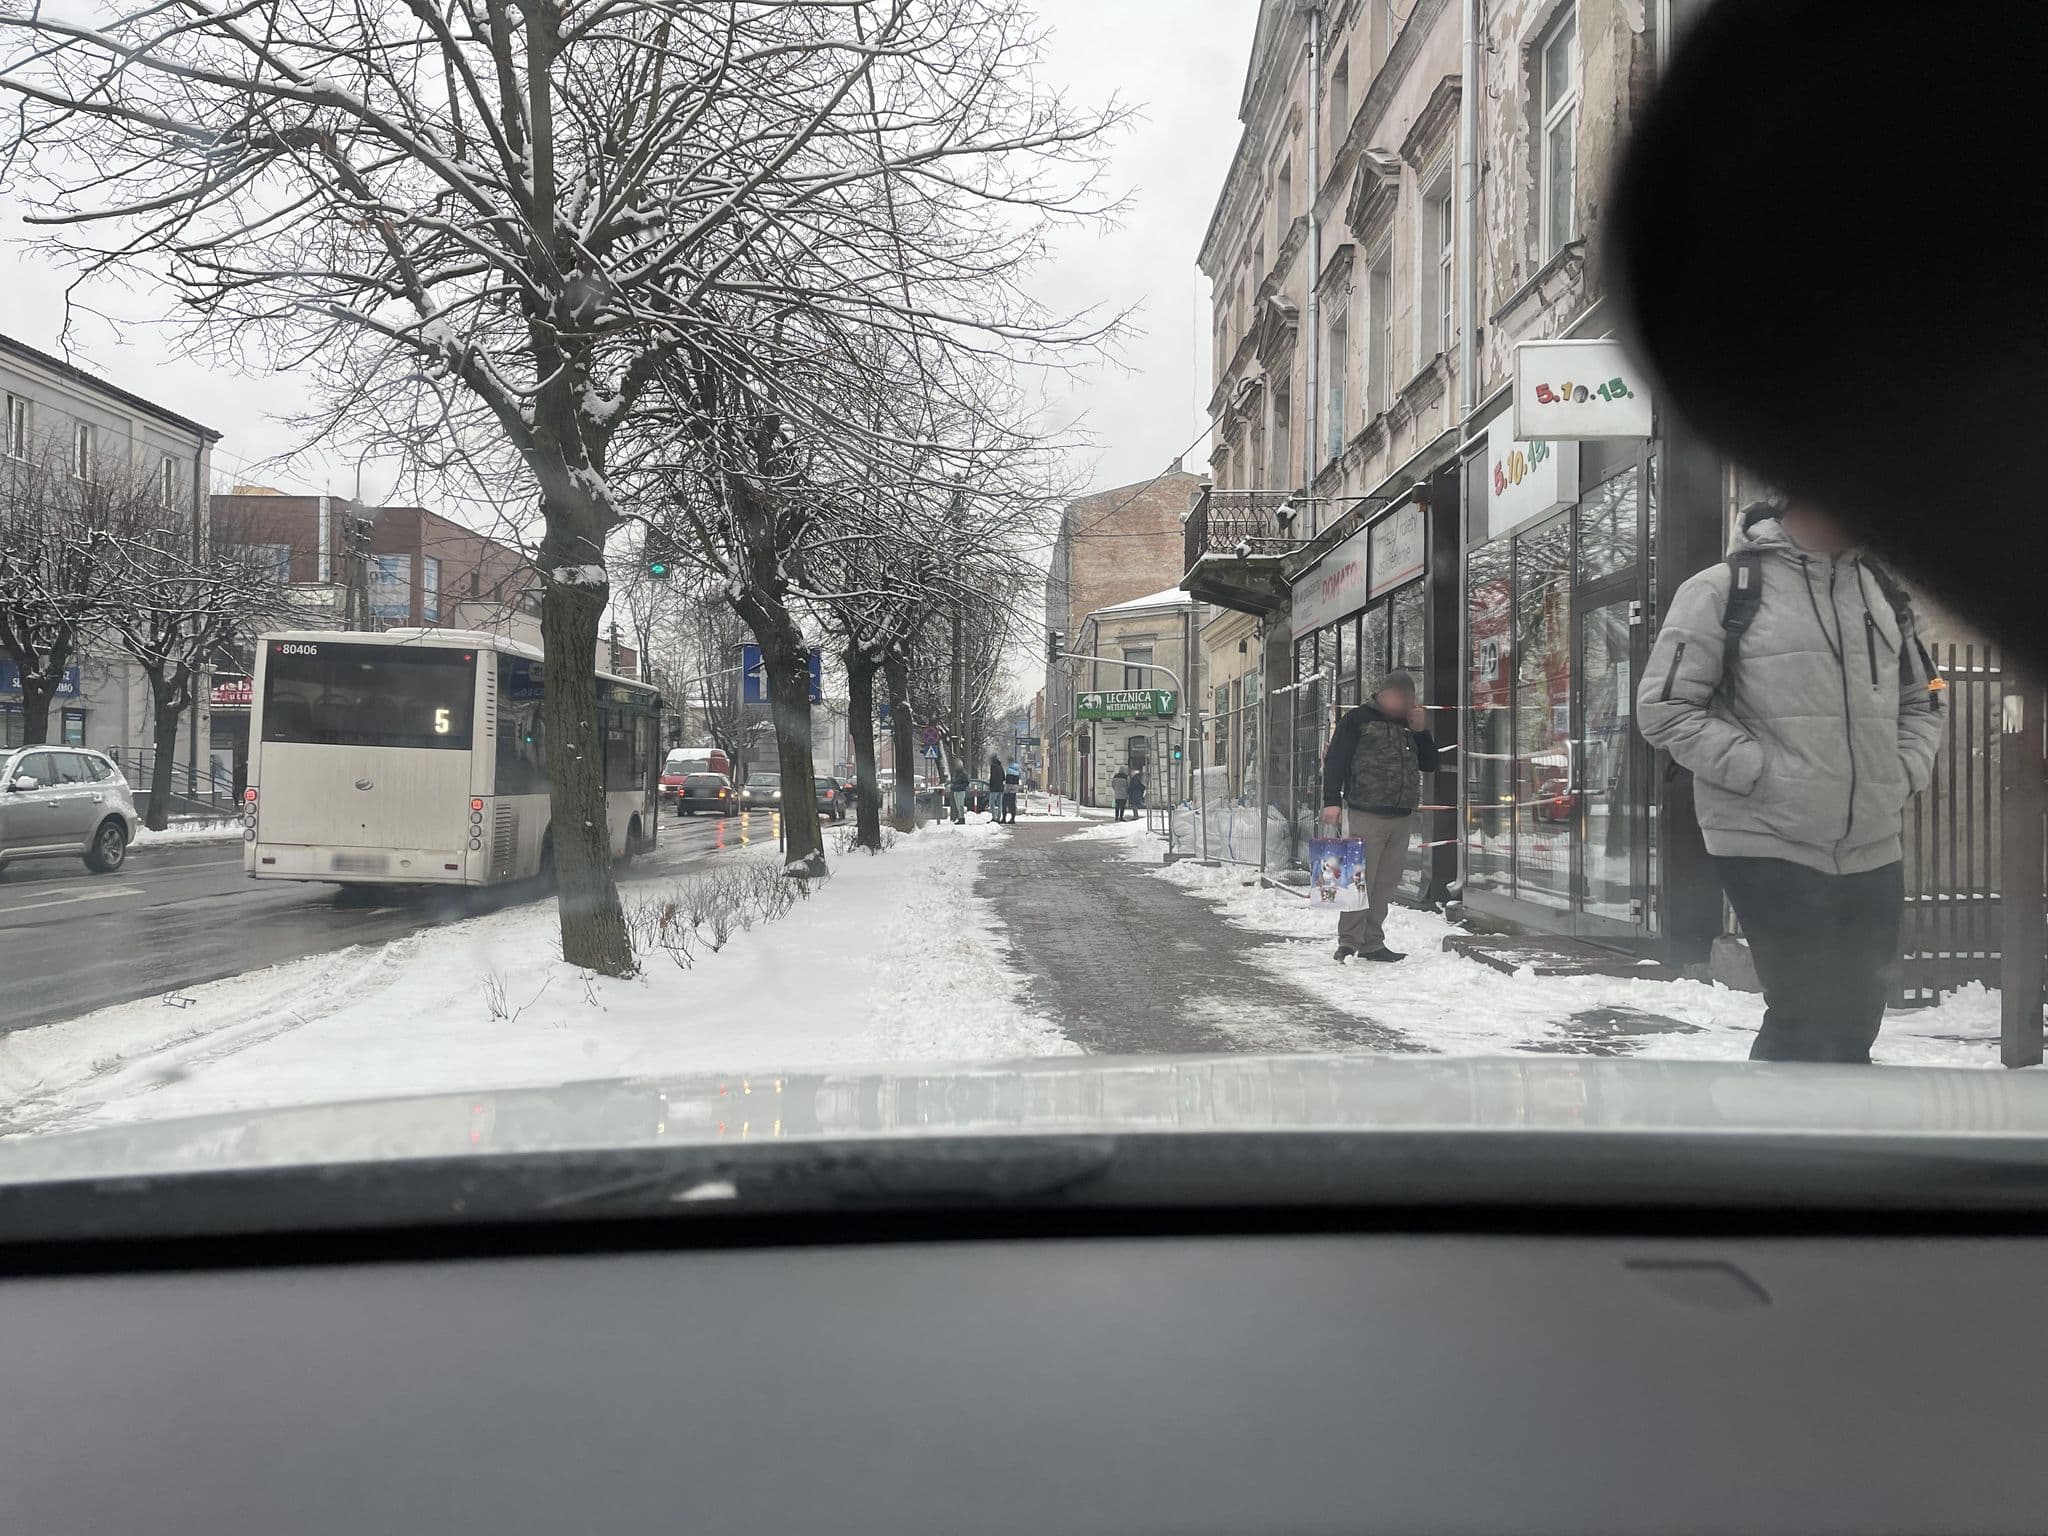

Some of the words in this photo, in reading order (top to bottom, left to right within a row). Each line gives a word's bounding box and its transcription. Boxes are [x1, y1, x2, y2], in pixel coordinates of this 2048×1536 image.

[1535, 377, 1634, 404] 5.10.15.
[282, 644, 317, 655] 80406
[1106, 691, 1152, 703] LECZNICA
[1106, 702, 1152, 711] WETERYNARYJNA
[434, 708, 449, 734] 5
